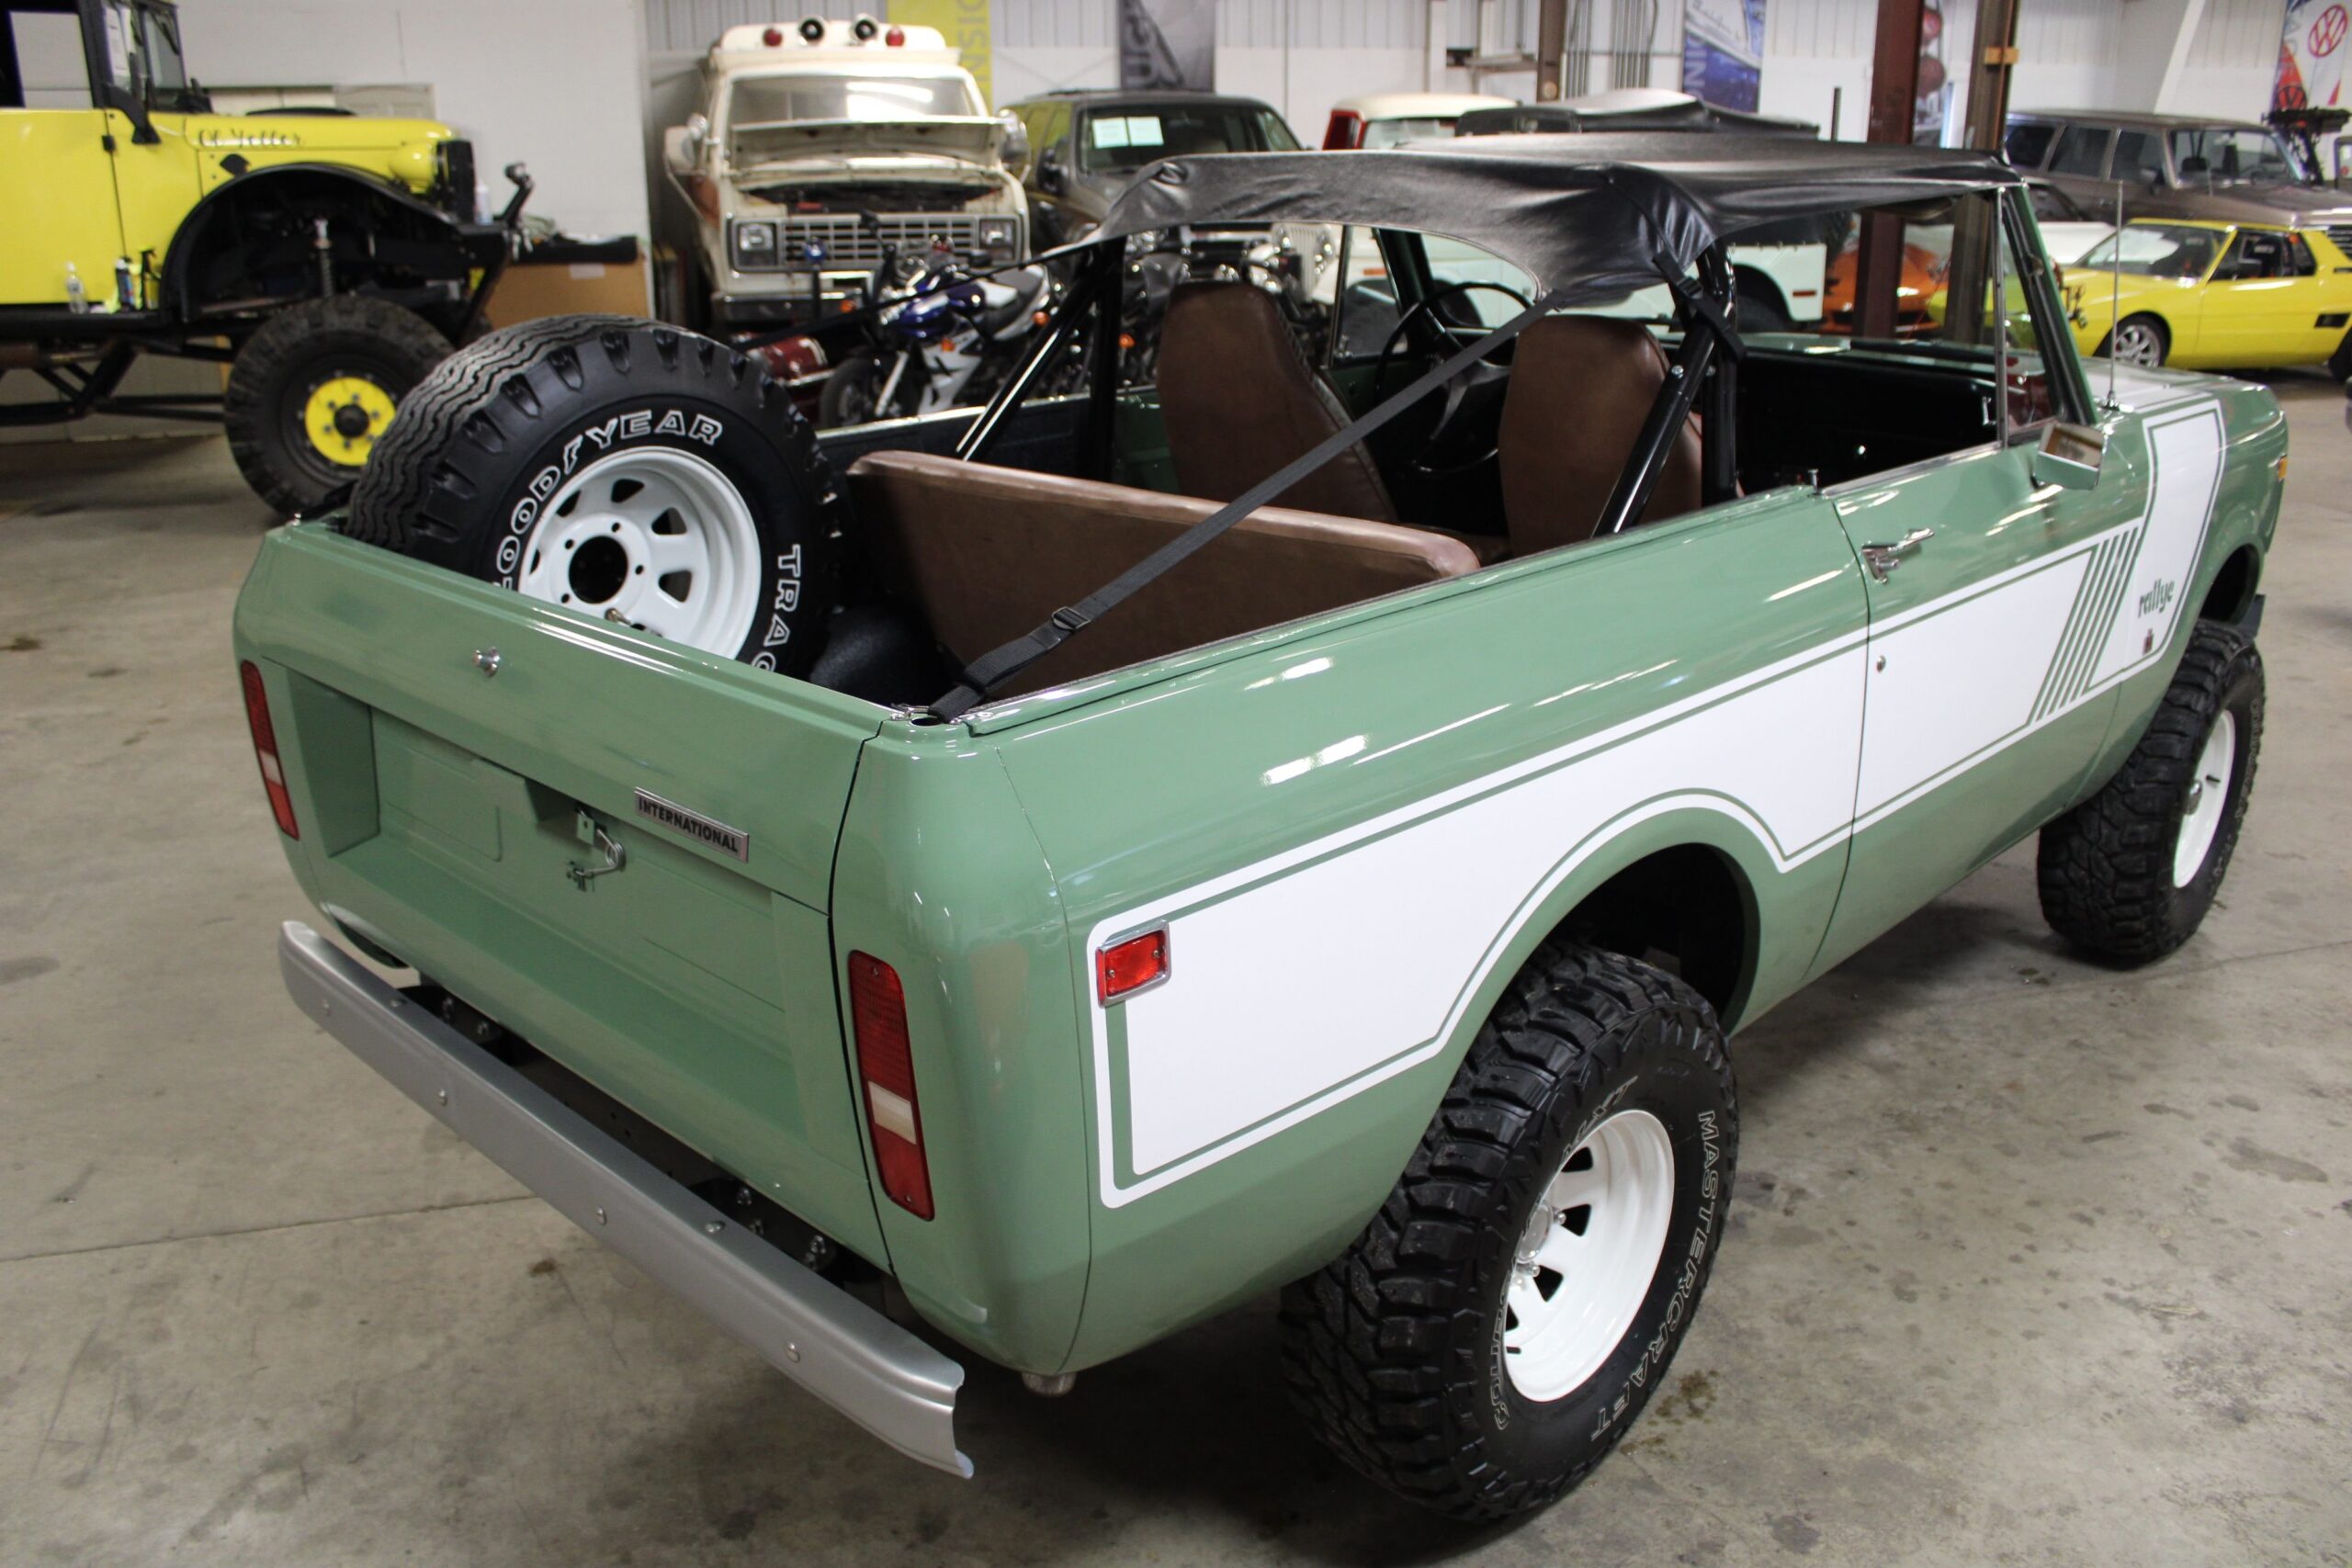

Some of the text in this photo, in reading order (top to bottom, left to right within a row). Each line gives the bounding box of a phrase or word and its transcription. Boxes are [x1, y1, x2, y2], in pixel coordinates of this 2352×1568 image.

[2138, 578, 2176, 619] rallye
[638, 795, 739, 853] INTERNATIONAL
[1590, 1111, 1721, 1442] MASTERCRAFT
